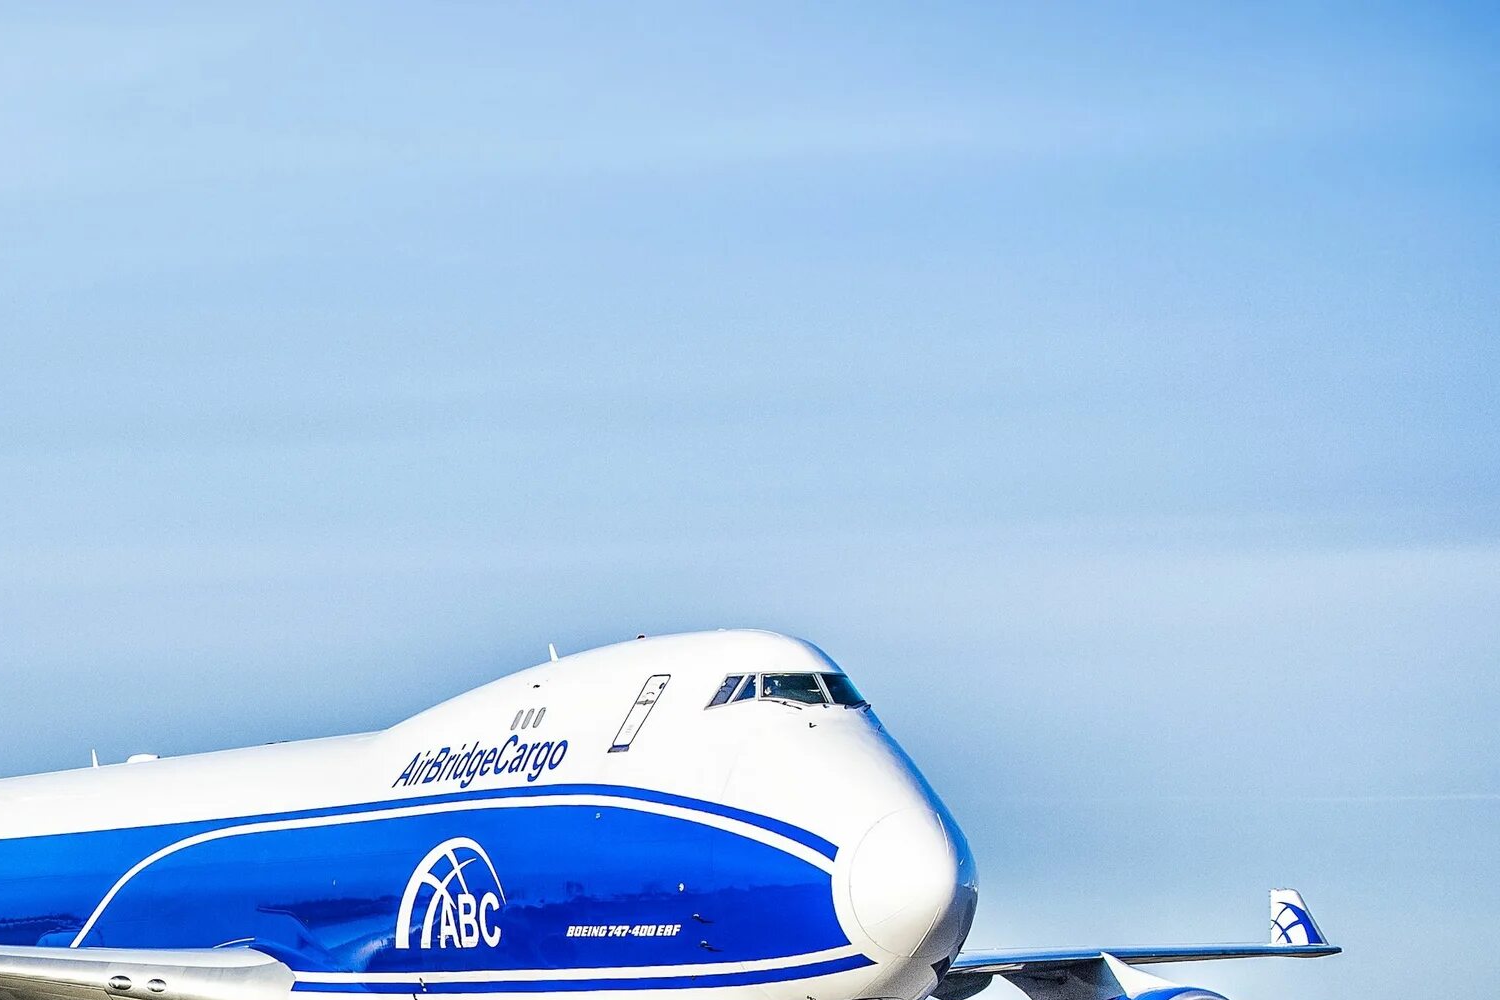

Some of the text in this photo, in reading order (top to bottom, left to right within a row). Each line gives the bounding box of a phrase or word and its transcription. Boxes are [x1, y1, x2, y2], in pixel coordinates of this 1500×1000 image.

[392, 734, 568, 788] AirBridgeCargo
[440, 892, 502, 949] ABC
[566, 925, 608, 937] BOEING
[656, 924, 681, 936] ERF
